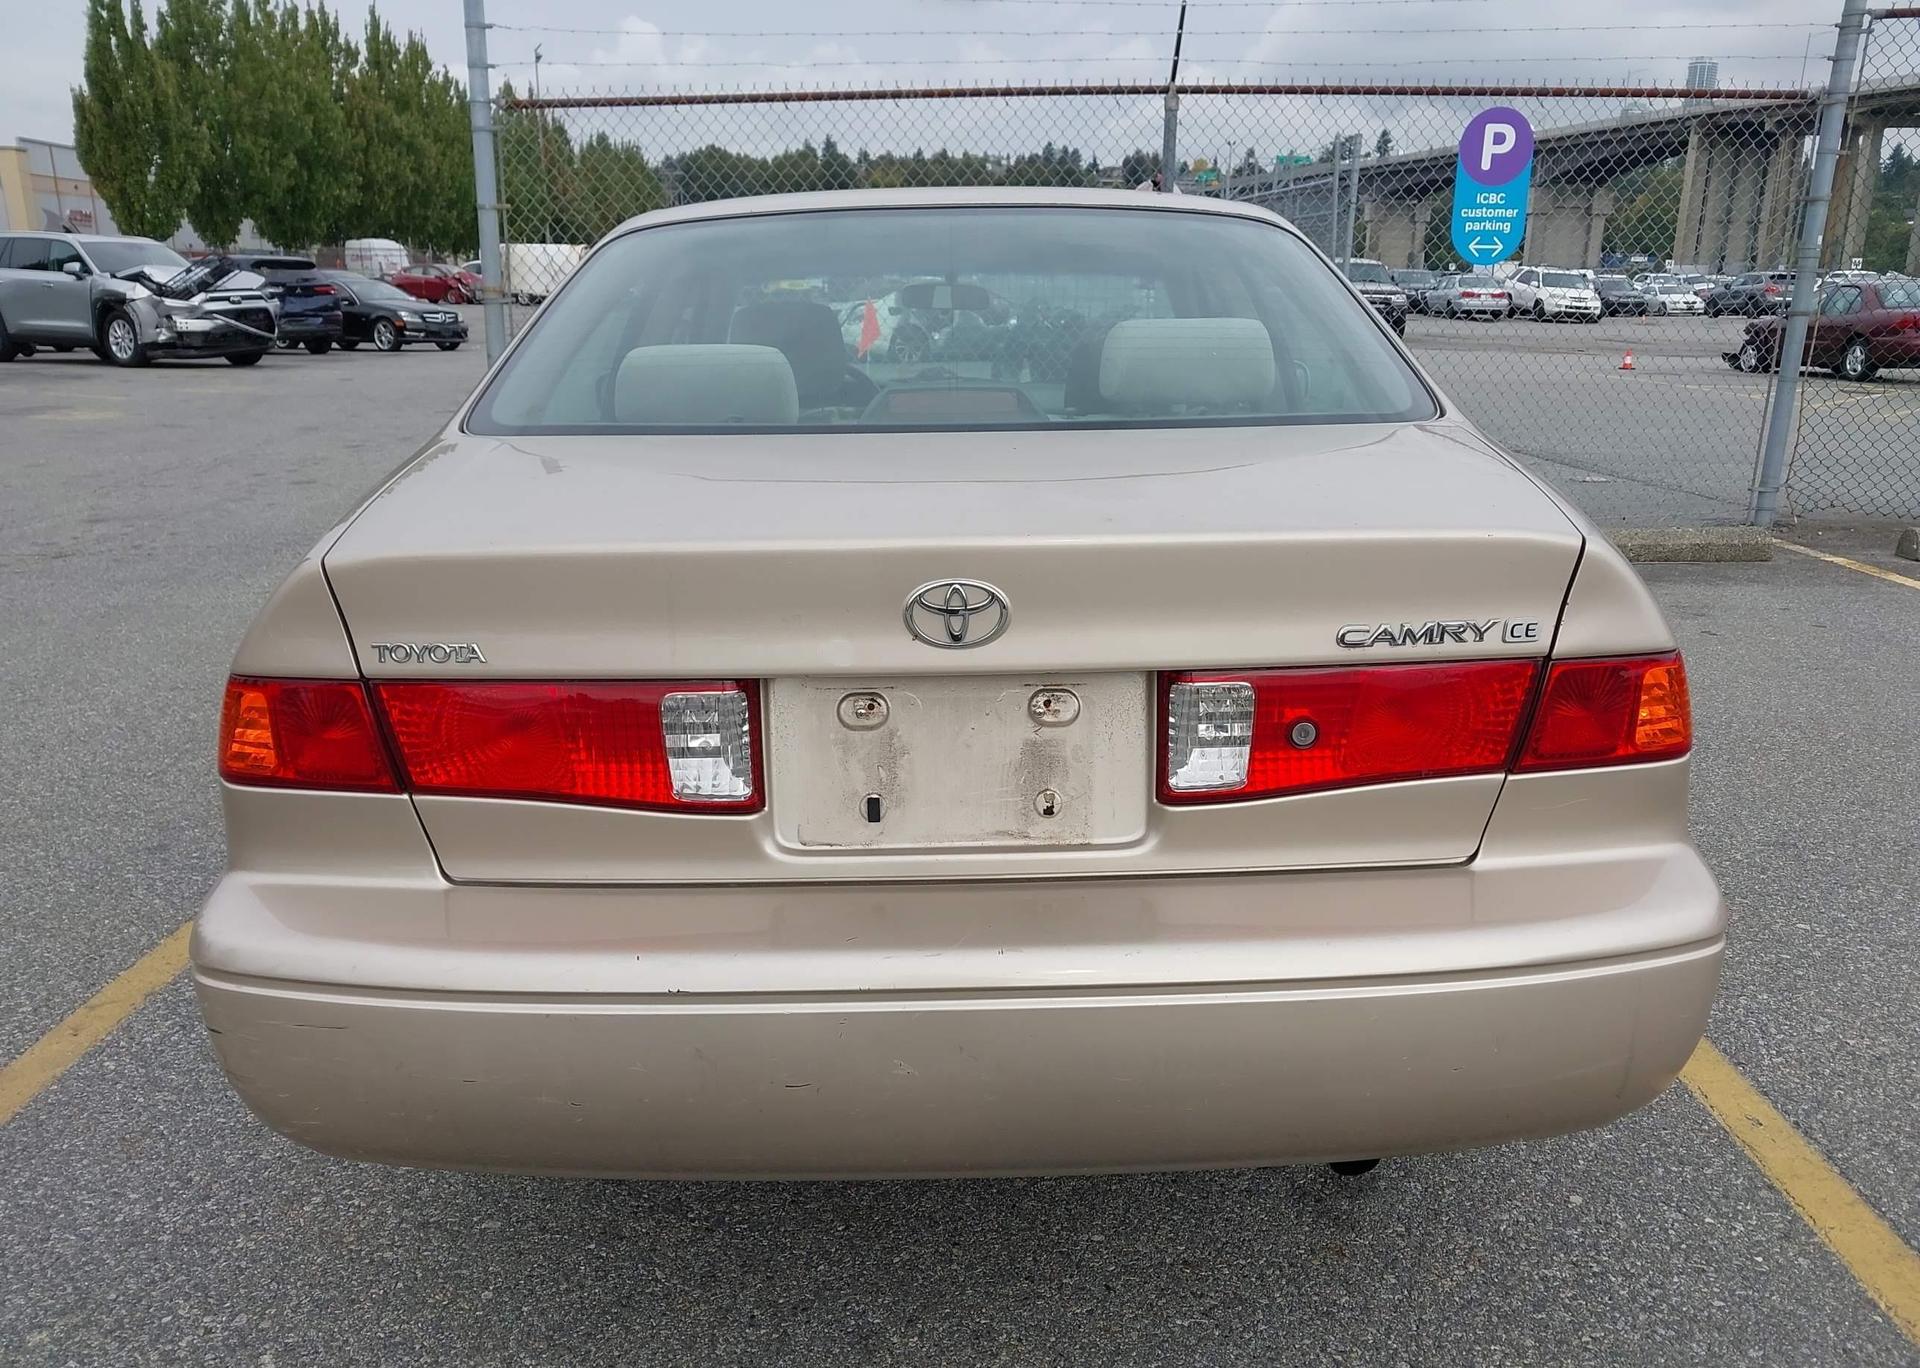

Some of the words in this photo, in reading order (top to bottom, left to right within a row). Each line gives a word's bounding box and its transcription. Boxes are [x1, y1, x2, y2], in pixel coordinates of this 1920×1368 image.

[1480, 123, 1517, 171] P
[1476, 193, 1506, 204] ICBC
[1461, 207, 1519, 218] customer
[1465, 220, 1511, 233] parking
[1336, 618, 1501, 648] CAMRY
[1510, 622, 1538, 639] CE
[371, 642, 488, 663] TOYOTA
